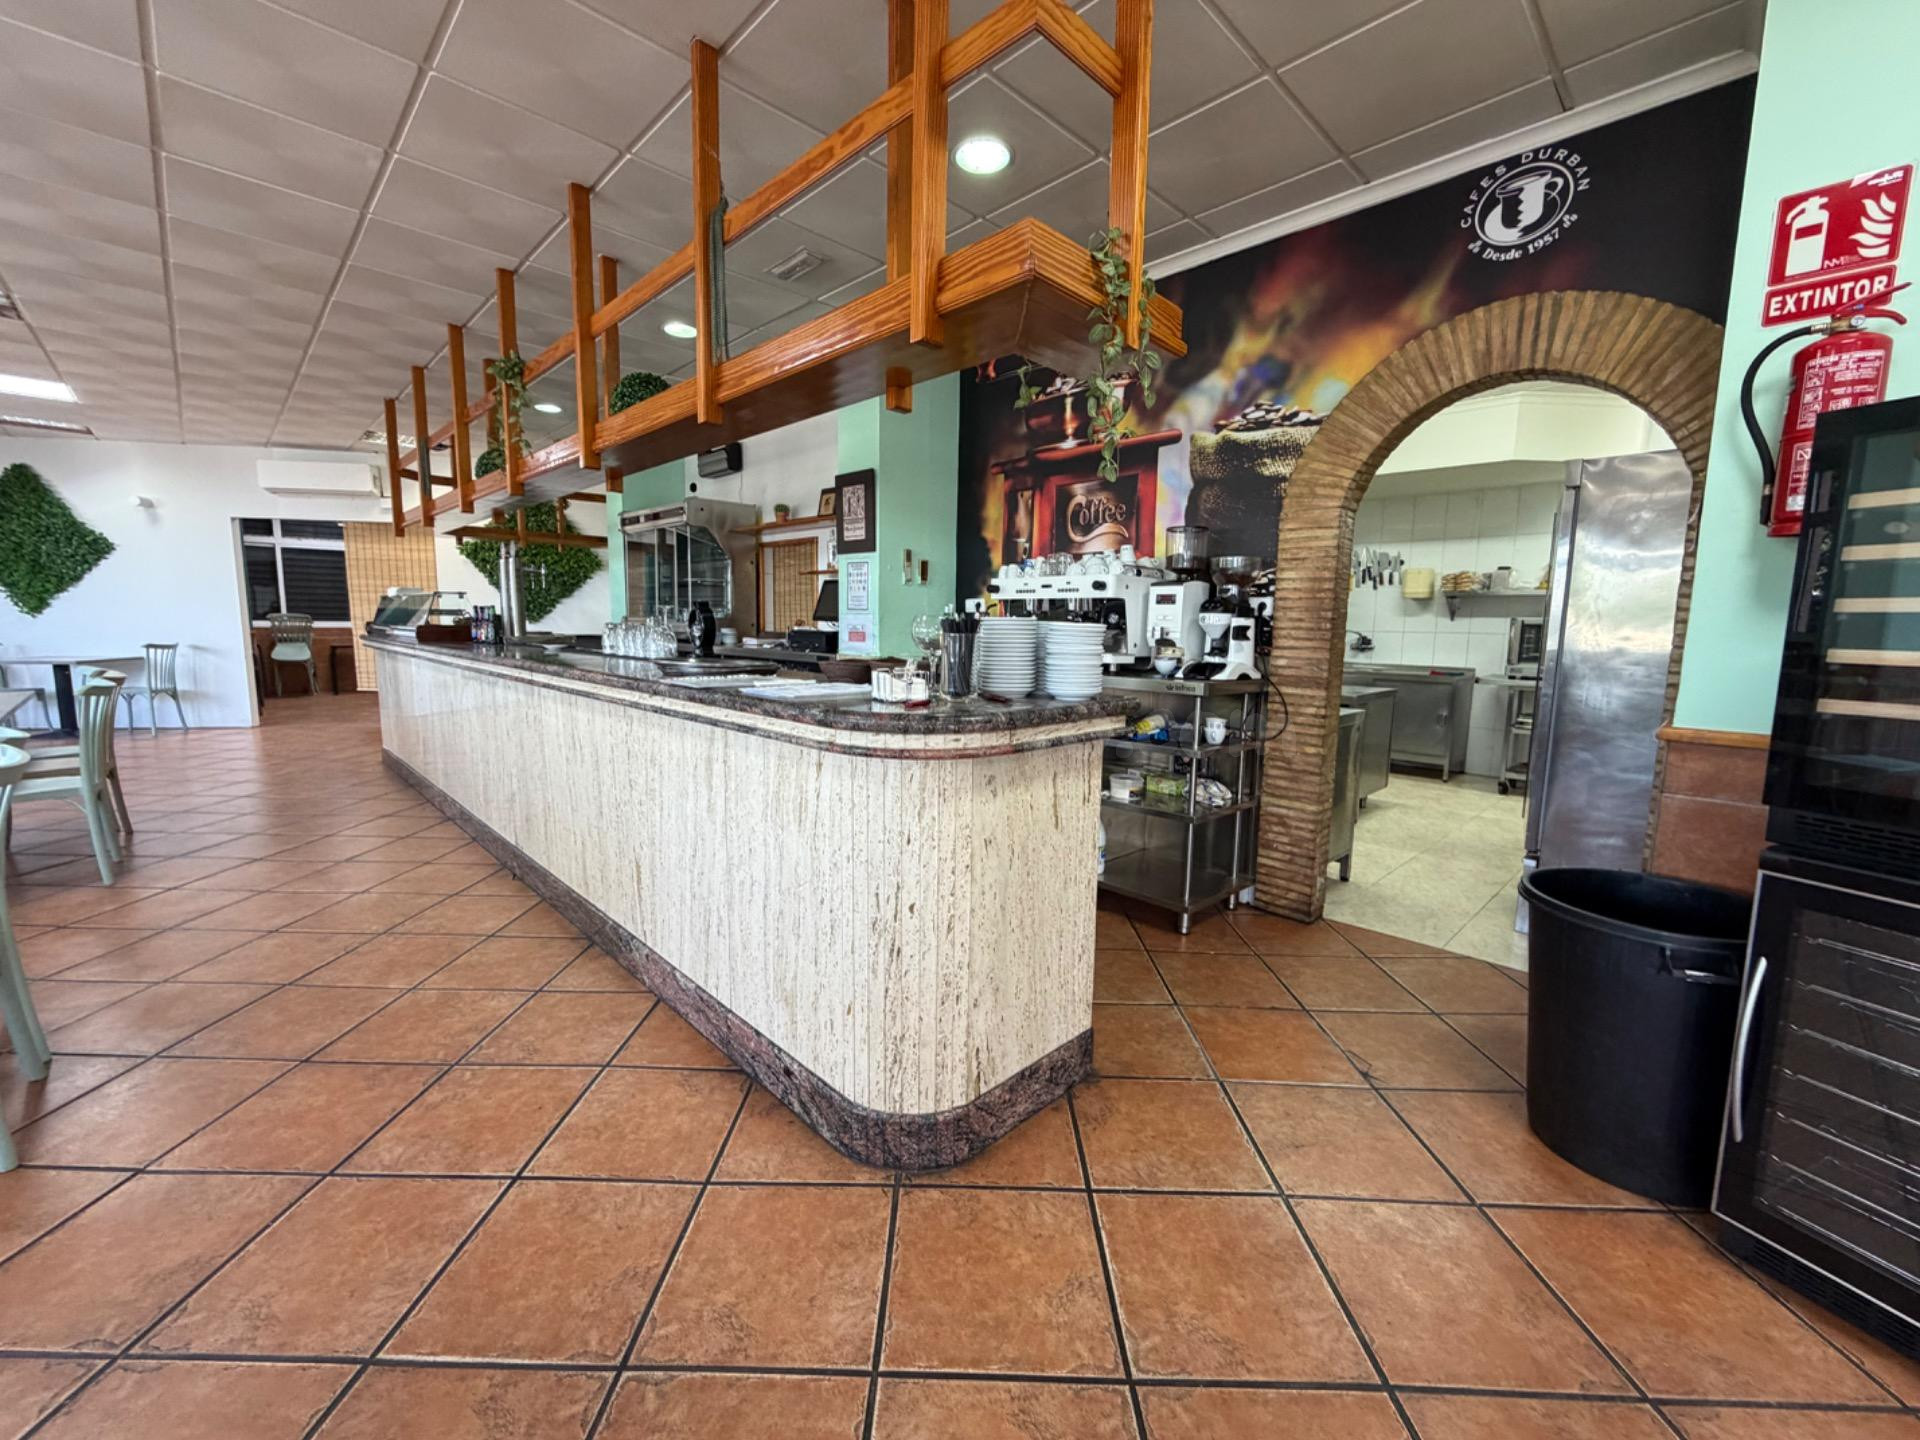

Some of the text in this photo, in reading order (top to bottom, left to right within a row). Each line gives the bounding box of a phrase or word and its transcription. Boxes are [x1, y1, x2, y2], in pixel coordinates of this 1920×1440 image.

[1460, 147, 1591, 229] CAFES DURBAN
[1482, 228, 1560, 262] Desde 1957
[1768, 275, 1889, 317] EXTINTOR
[1066, 493, 1129, 543] Coffee
